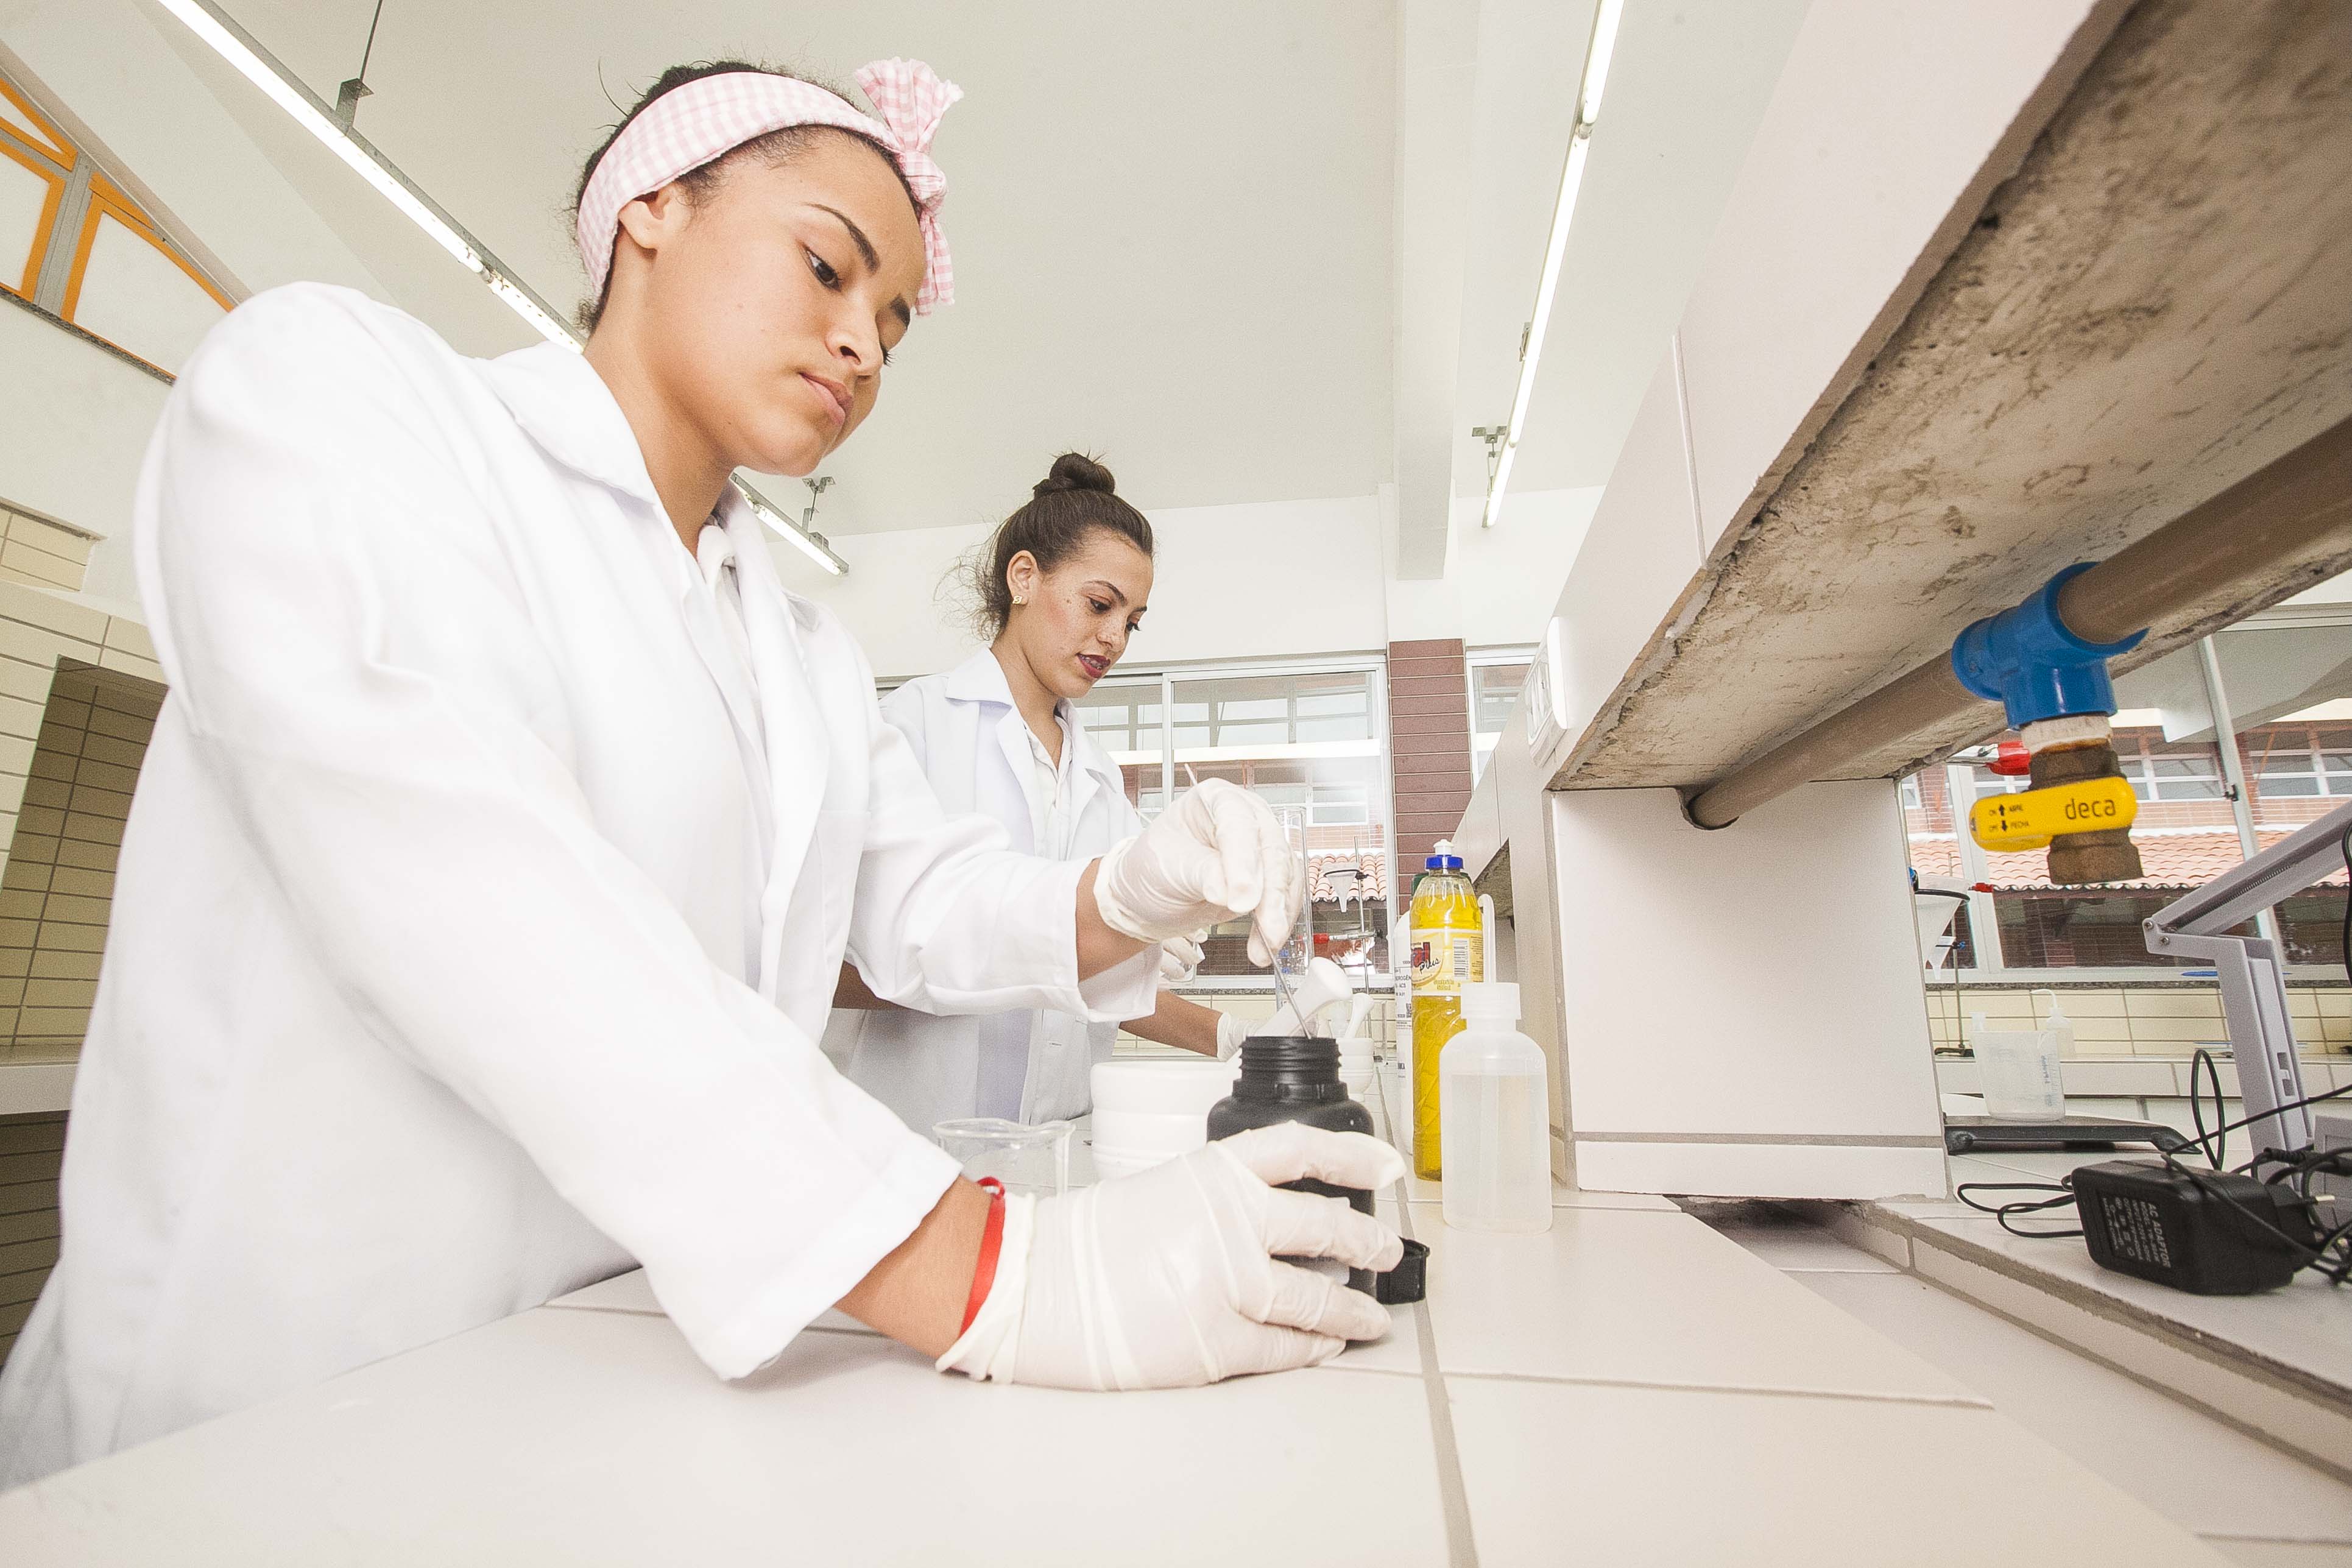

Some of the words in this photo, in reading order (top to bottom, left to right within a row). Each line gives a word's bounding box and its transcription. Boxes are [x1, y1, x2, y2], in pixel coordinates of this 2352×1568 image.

[2065, 798, 2116, 820] deca
[2147, 1203, 2159, 1218] AC
[2152, 1220, 2172, 1268] ADAPTOR
